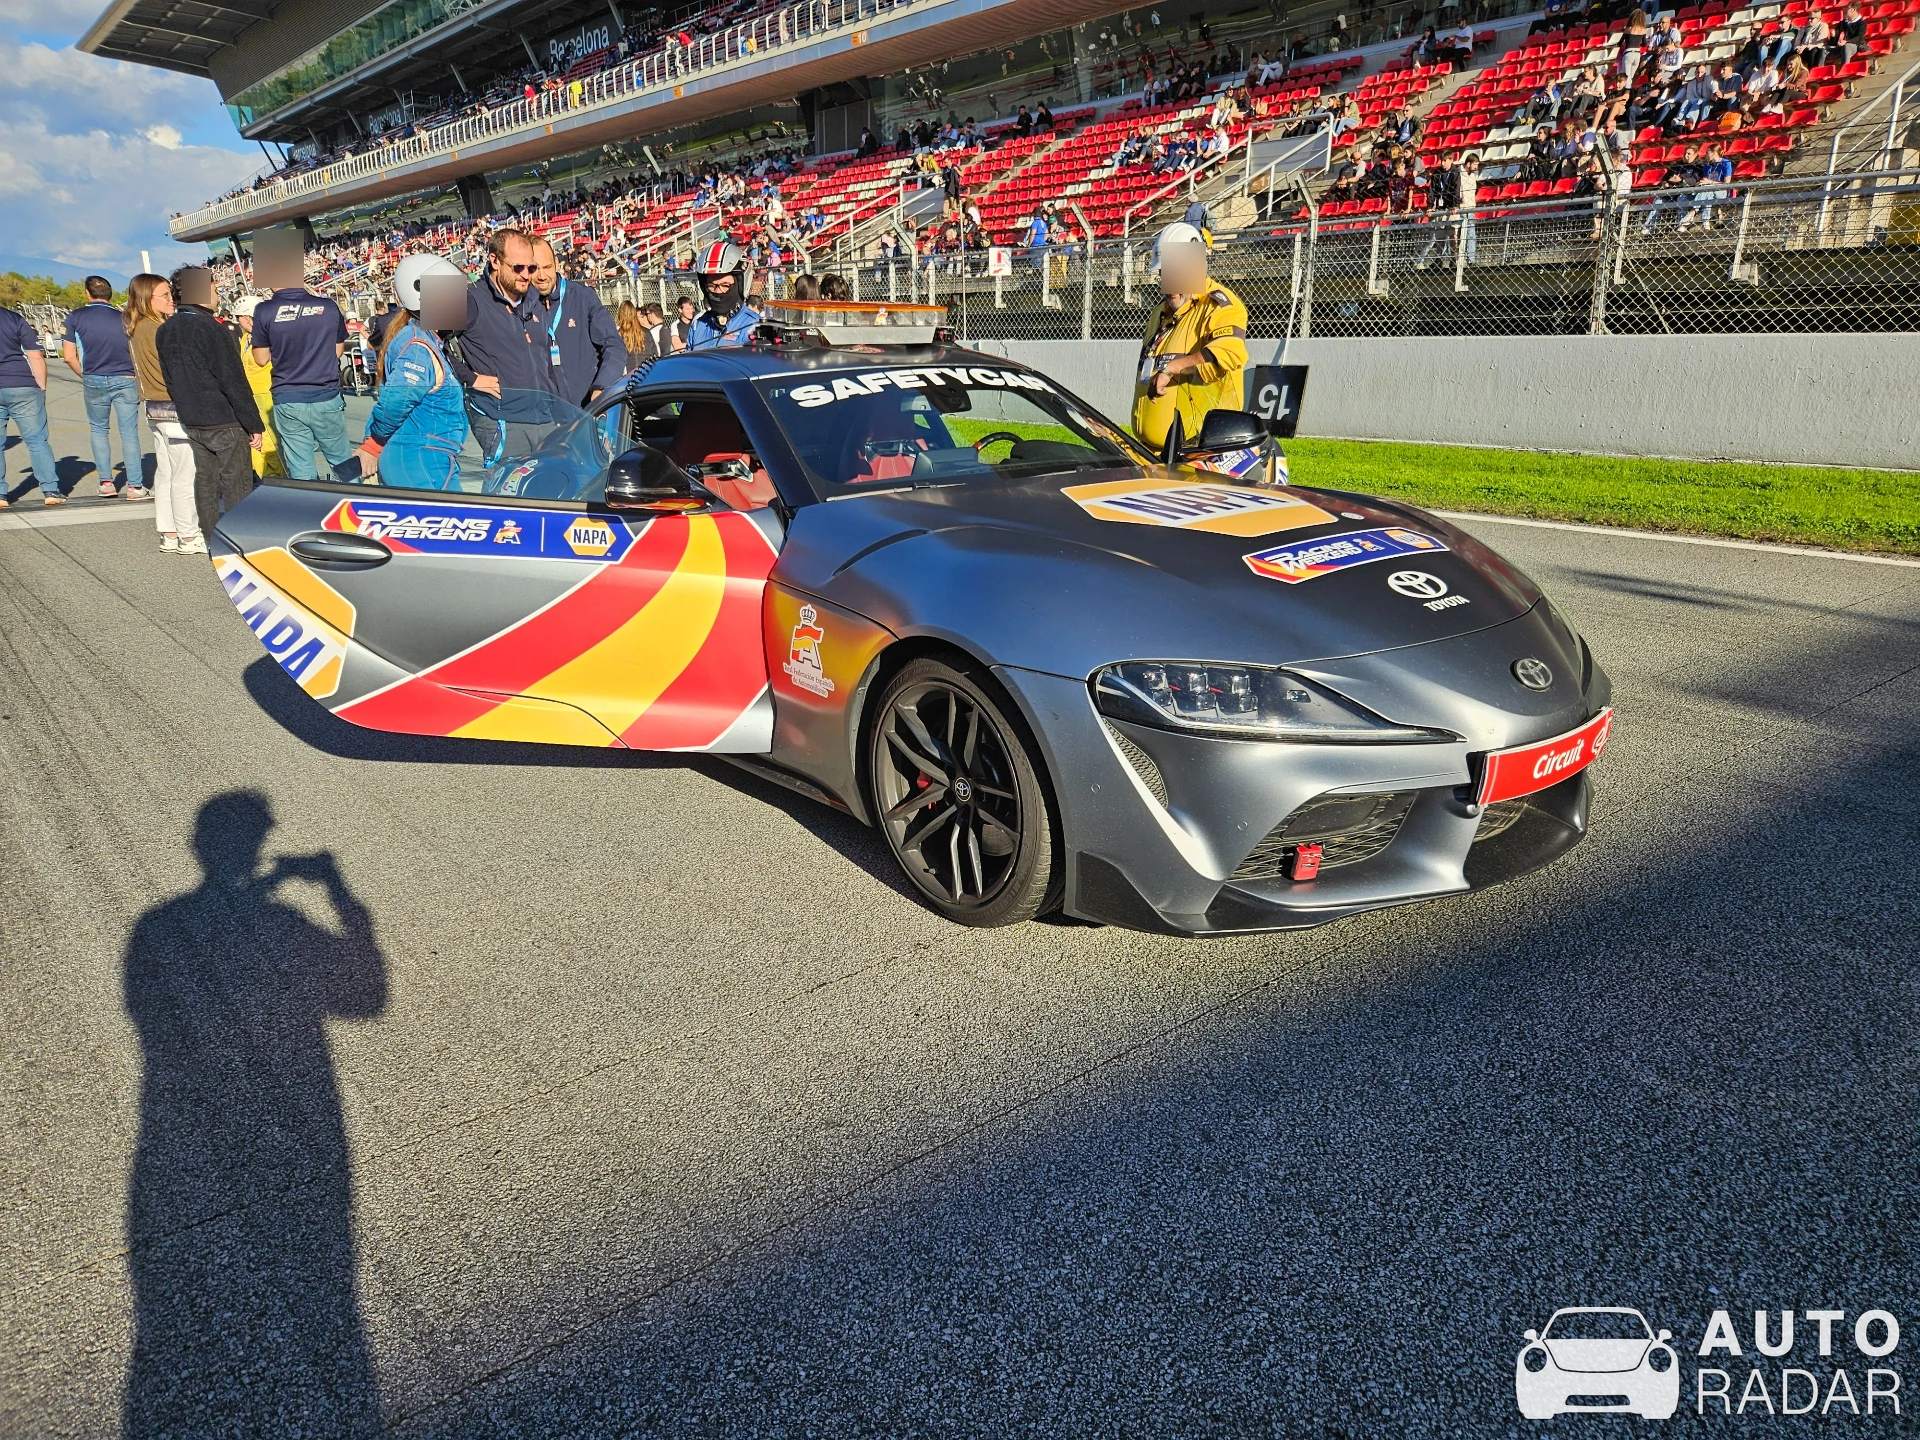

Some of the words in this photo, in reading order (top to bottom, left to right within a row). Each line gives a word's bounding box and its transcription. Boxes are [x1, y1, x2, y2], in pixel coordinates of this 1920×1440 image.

[1102, 487, 1290, 521] NAPA
[357, 510, 493, 532] RACING
[357, 523, 488, 541] WEEKEND
[573, 528, 608, 546] NAPA
[1264, 541, 1354, 566] RACING
[1277, 546, 1363, 574] WEEKEND
[1422, 595, 1471, 612] TOYOTA
[1533, 738, 1584, 779] Circuit
